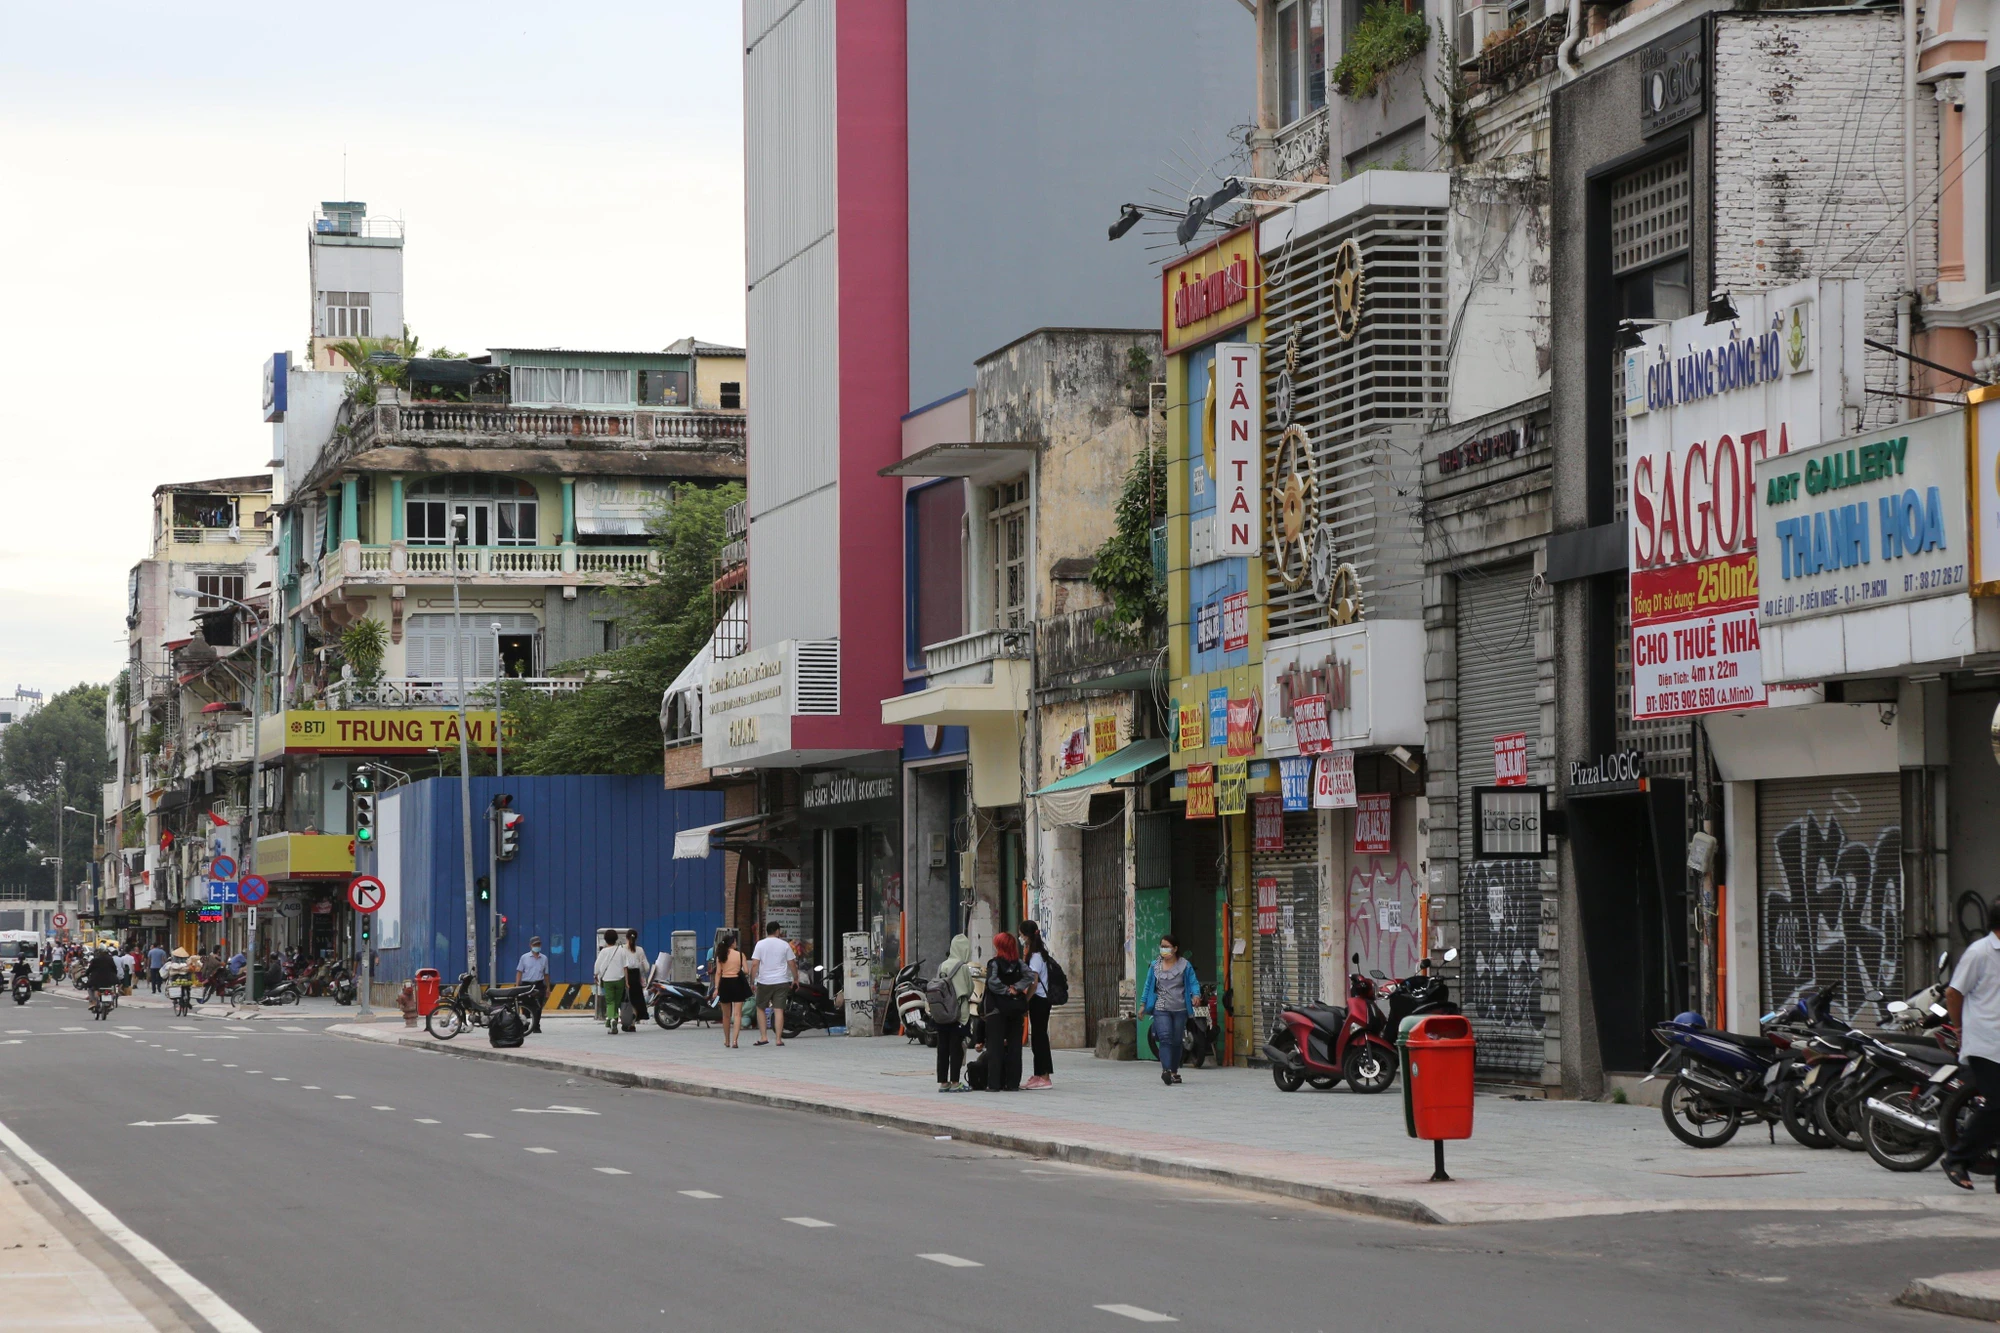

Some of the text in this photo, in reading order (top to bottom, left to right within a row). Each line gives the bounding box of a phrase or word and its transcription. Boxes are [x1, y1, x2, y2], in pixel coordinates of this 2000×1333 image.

[1678, 343, 1714, 404] HÀNG
[1718, 321, 1756, 393] ĐỒNG
[1759, 311, 1784, 382] HỒ
[1229, 357, 1250, 441] TÂN
[1766, 436, 1909, 506] ART GALLERY
[1230, 460, 1250, 545] TÂN
[1776, 486, 1947, 580] THANH HOA
[1634, 590, 1652, 617] Tổng
[1653, 593, 1663, 611] DT
[1674, 590, 1695, 612] dụng:
[1697, 556, 1759, 604] 250m2
[1765, 600, 1773, 617] 40
[1861, 579, 1887, 600] TP.HCM
[1919, 571, 1929, 590] 38
[1931, 568, 1941, 587] 27
[1942, 567, 1951, 586] 26
[1954, 564, 1963, 584] 27
[1636, 611, 1761, 666] CHO THUÊ NHÀ
[1658, 672, 1673, 689] Diện
[1691, 665, 1706, 683] 4m
[1708, 665, 1715, 680] x
[1717, 659, 1738, 681] 22m
[1646, 695, 1658, 713] ĐT:
[1659, 691, 1679, 711] 0975
[1682, 689, 1697, 709] 902
[1700, 687, 1715, 707] 650
[1717, 687, 1754, 705] (A.Minh)
[305, 720, 325, 734] BTJ
[337, 720, 423, 742] TRUNG
[430, 715, 482, 742] TÂM
[1569, 761, 1600, 786] Pizza
[283, 903, 301, 911] ACB
